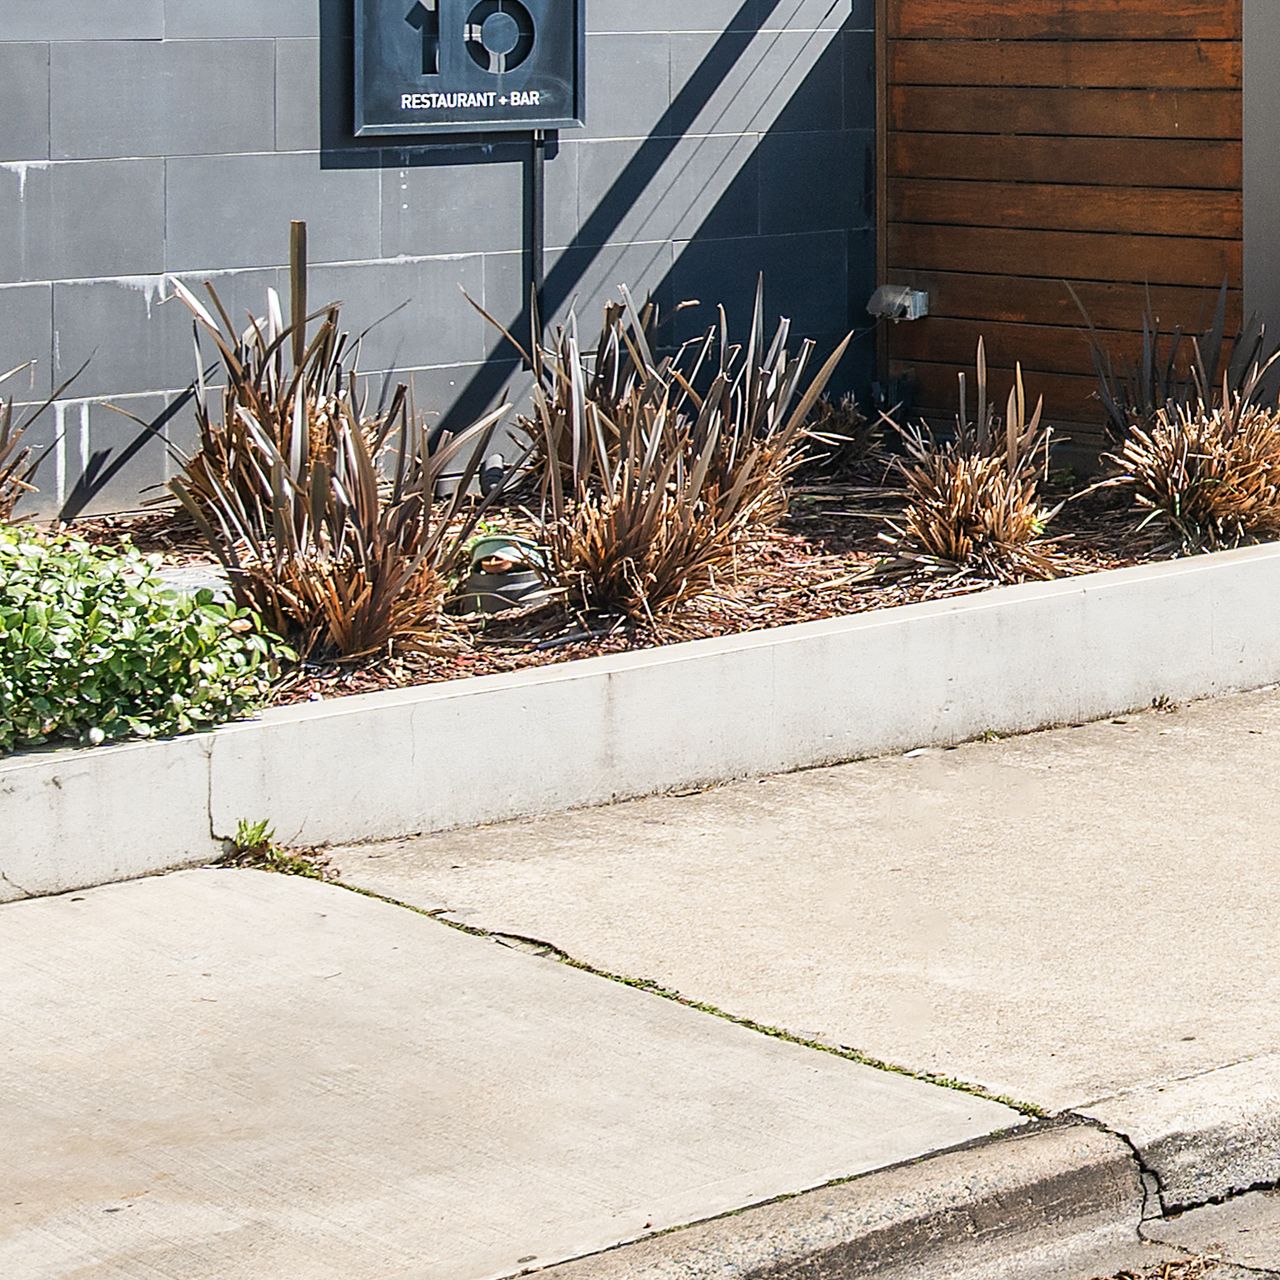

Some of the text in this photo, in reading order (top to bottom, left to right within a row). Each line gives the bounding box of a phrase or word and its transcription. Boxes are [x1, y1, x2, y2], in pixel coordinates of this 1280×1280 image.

[401, 91, 540, 109] RESTAURANT + BAR
